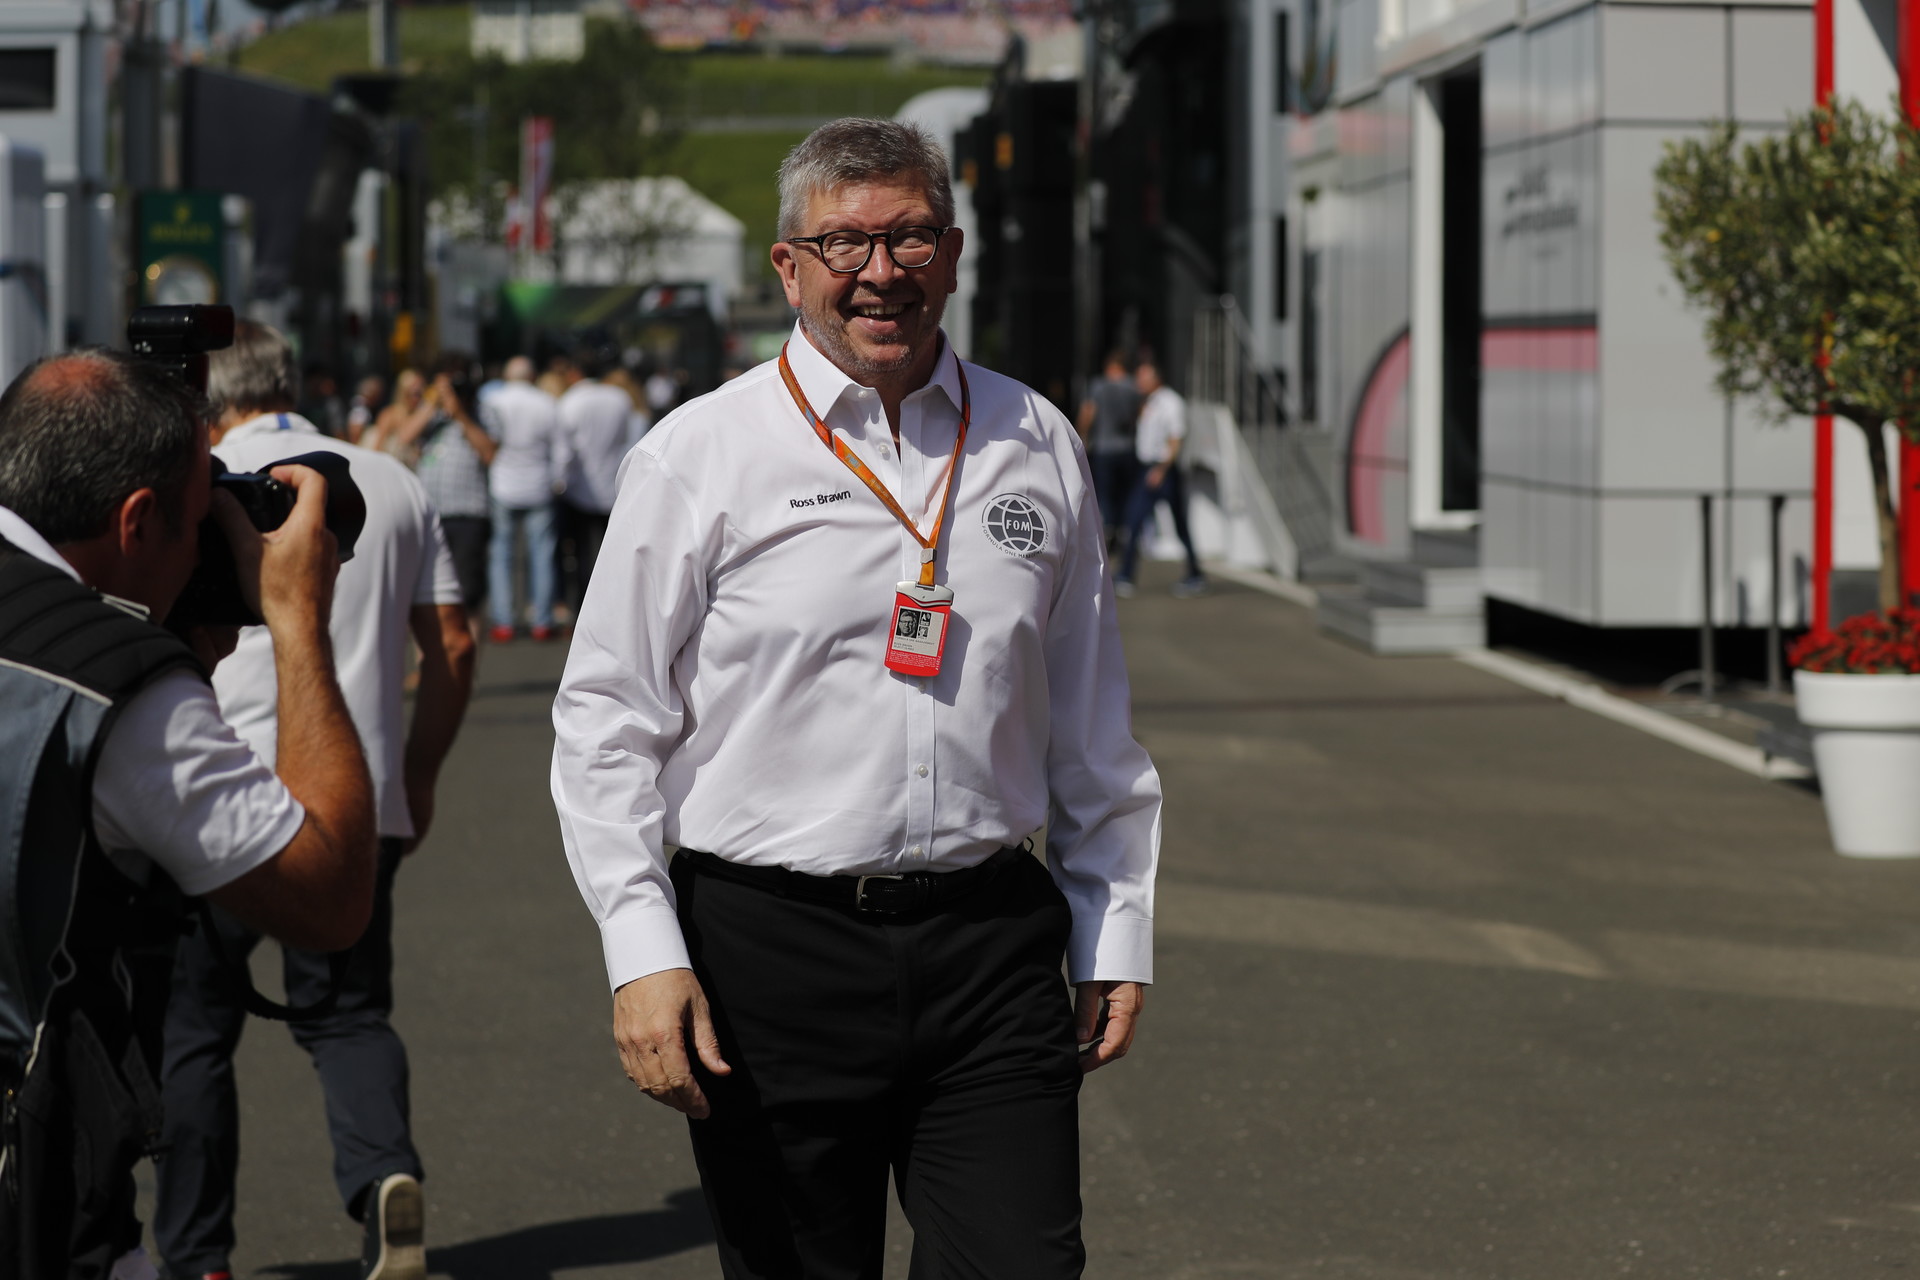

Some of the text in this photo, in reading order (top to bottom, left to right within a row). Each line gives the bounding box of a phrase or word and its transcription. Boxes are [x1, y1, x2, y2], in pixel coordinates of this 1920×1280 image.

[790, 490, 851, 508] Ross Brawn
[1006, 519, 1030, 532] FOM
